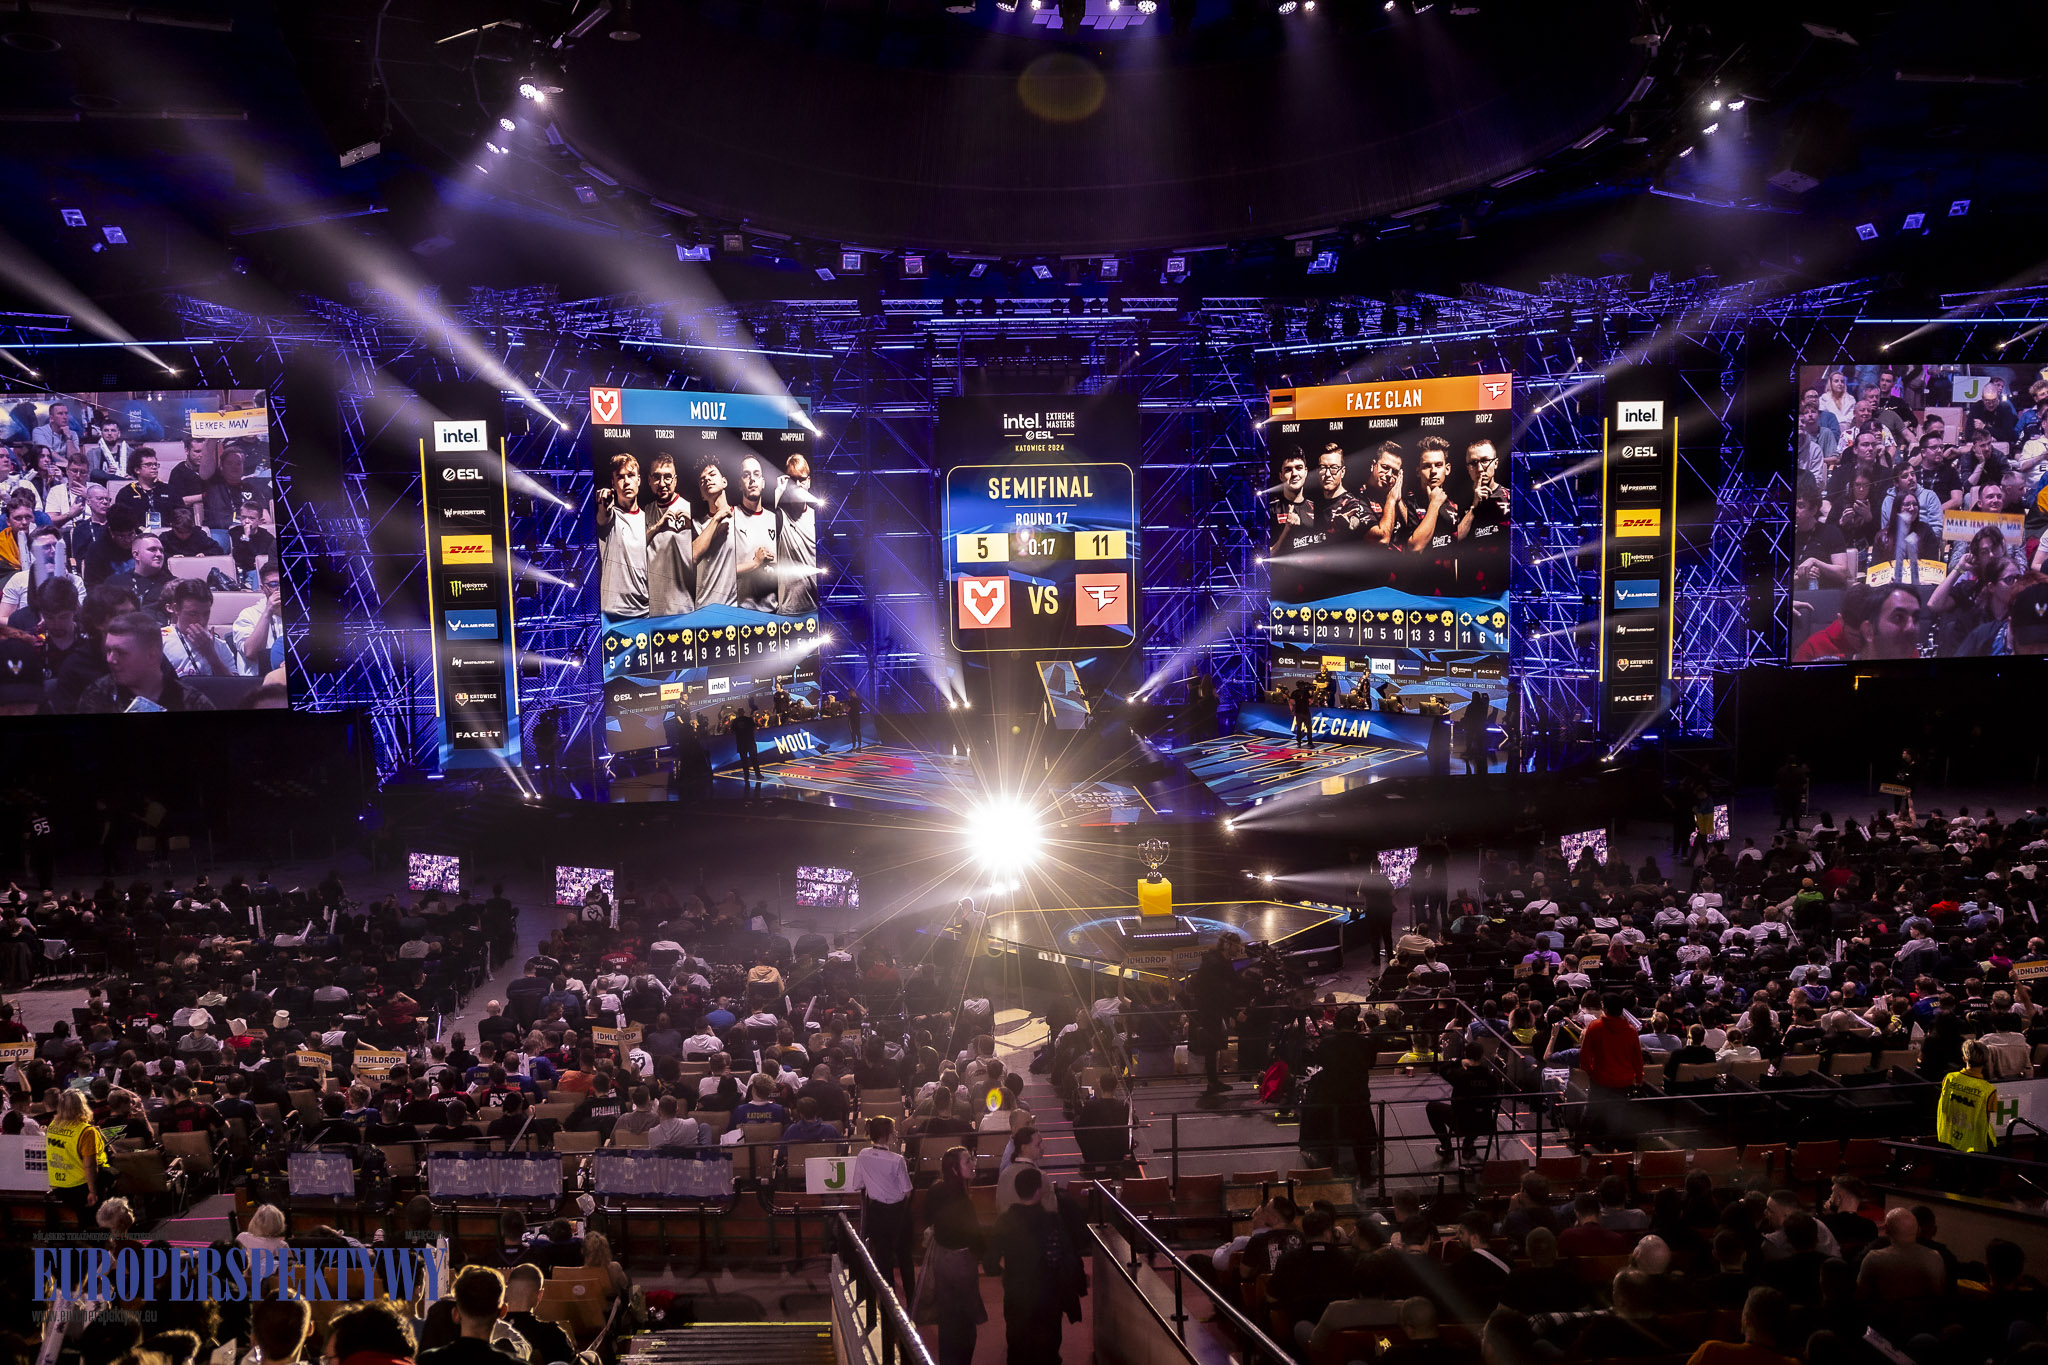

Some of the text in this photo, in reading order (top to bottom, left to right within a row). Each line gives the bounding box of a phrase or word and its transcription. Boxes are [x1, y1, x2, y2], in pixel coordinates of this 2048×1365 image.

[1964, 380, 1979, 399] J
[1346, 389, 1422, 411] FAZE CLAN
[690, 401, 727, 420] MOUZ
[1046, 412, 1075, 420] EXTREME
[195, 419, 249, 430] LEKKER MAN
[1046, 420, 1075, 429] MASTERS
[1368, 418, 1398, 429] KARRIGAN
[1421, 416, 1445, 426] FROZEN
[1475, 414, 1492, 424] ROPZ
[1282, 424, 1300, 433] BROKY
[1329, 421, 1344, 431] RAIN
[604, 428, 631, 438] BROLLAN
[655, 429, 675, 439] TORZSI
[741, 431, 763, 441] XERTION
[1035, 431, 1055, 439] ESL
[1015, 443, 1065, 452] KATOWICE 2024
[1634, 446, 1658, 457] ESL
[456, 468, 484, 480] ESL
[988, 475, 1093, 500] SEMIFINAL
[1015, 511, 1068, 526] ROUND 17
[1623, 519, 1654, 527] DHL
[449, 545, 486, 554] DHL
[977, 536, 989, 559] 5
[1028, 538, 1056, 556] 0:17
[1092, 534, 1109, 556] 11
[1028, 586, 1059, 615] VS
[1274, 625, 1309, 637] 13 4 5
[1316, 626, 1354, 638] 20 3 7
[1363, 627, 1403, 640] 10 5 10
[1410, 629, 1451, 642] 13 3 9
[1461, 631, 1504, 645] 11 6 11
[701, 644, 736, 660] 9 2 15
[744, 640, 777, 655] 5 0 12
[609, 653, 648, 669] 5 2 15
[654, 648, 693, 665] 14 2 14
[1375, 662, 1391, 670] intel
[711, 681, 727, 690] intel
[1614, 694, 1655, 702] FACEIT
[1330, 717, 1371, 738] CLAN
[456, 730, 501, 739] FACEIT
[774, 732, 816, 754] MOUZ
[301, 1055, 330, 1066] !DHLDROP
[359, 1056, 401, 1064] !DHLDROP
[1950, 1082, 1982, 1095] SECURITY
[1996, 1099, 2019, 1125] H
[824, 1162, 846, 1189] J
